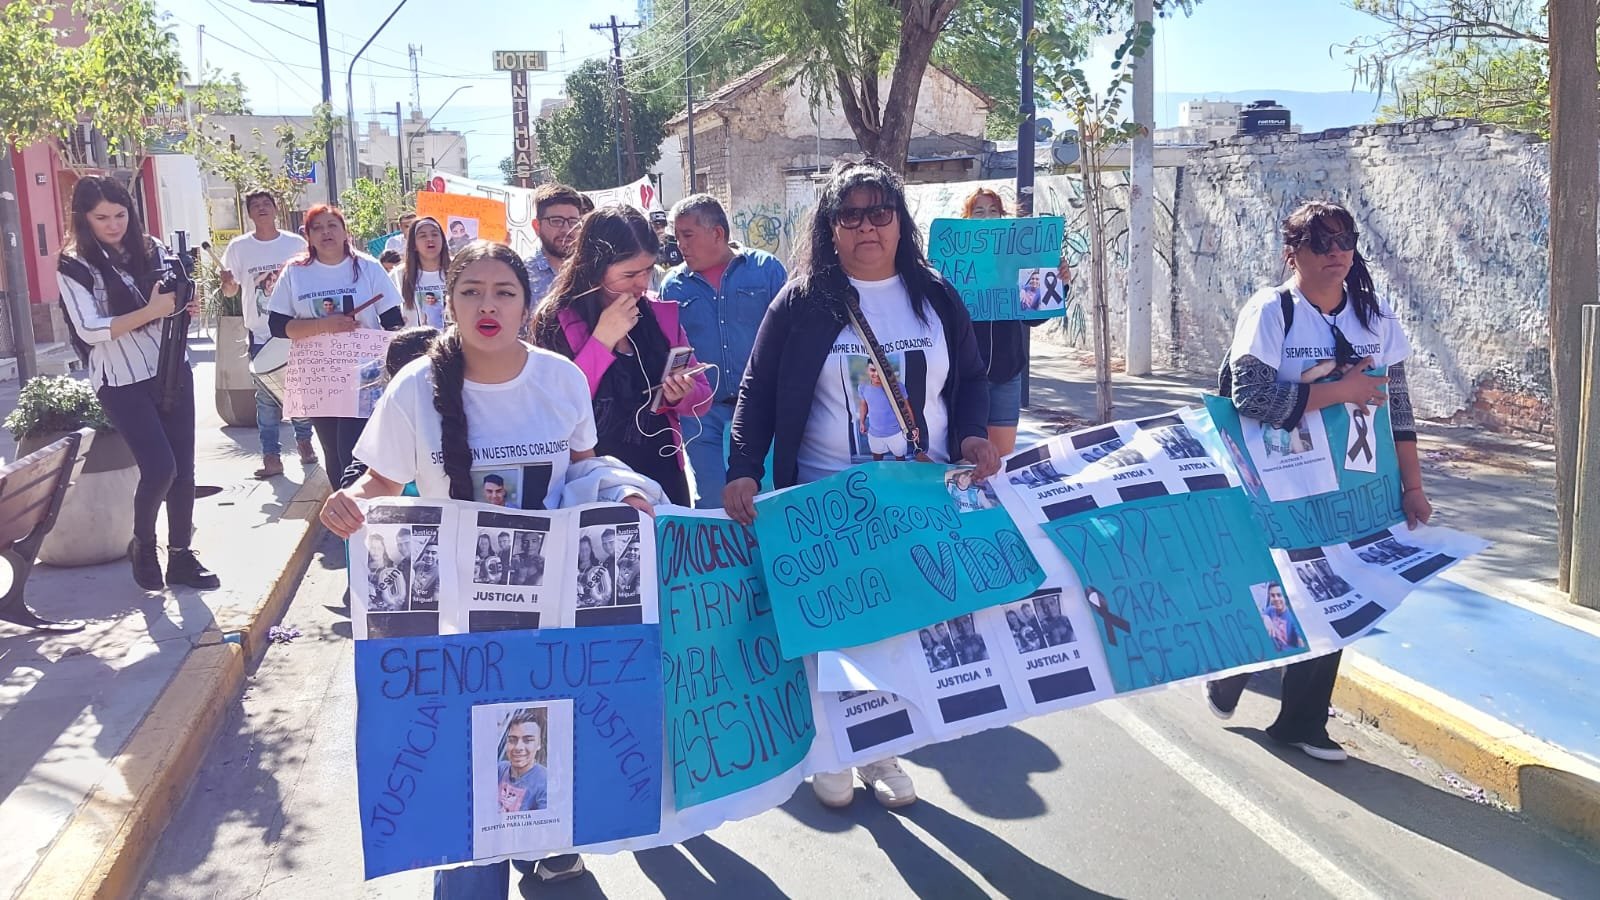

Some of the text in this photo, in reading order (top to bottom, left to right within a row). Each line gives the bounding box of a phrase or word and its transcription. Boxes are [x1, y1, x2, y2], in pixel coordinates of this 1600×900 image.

[494, 52, 545, 70] HOTEL
[895, 337, 933, 351] CORAZONES
[1285, 347, 1312, 358] SIEMPRE
[1313, 347, 1323, 358] EN
[482, 444, 528, 460] NUESTROS
[1113, 470, 1147, 481] JUSTICIA
[1179, 463, 1209, 472] JUSTICIA
[1037, 484, 1075, 499] JUSTICIA
[785, 470, 877, 543] NOS
[1288, 475, 1404, 544] MIGUEL
[473, 591, 525, 603] JUSTICIA
[798, 567, 892, 629] UNA
[1112, 570, 1233, 624] PARA LOS
[380, 637, 647, 700] SEÑOR JUEZ
[1025, 652, 1070, 670] JUSTICIA
[936, 670, 981, 689] JUSTICIA
[844, 696, 889, 718] JUSTICIA
